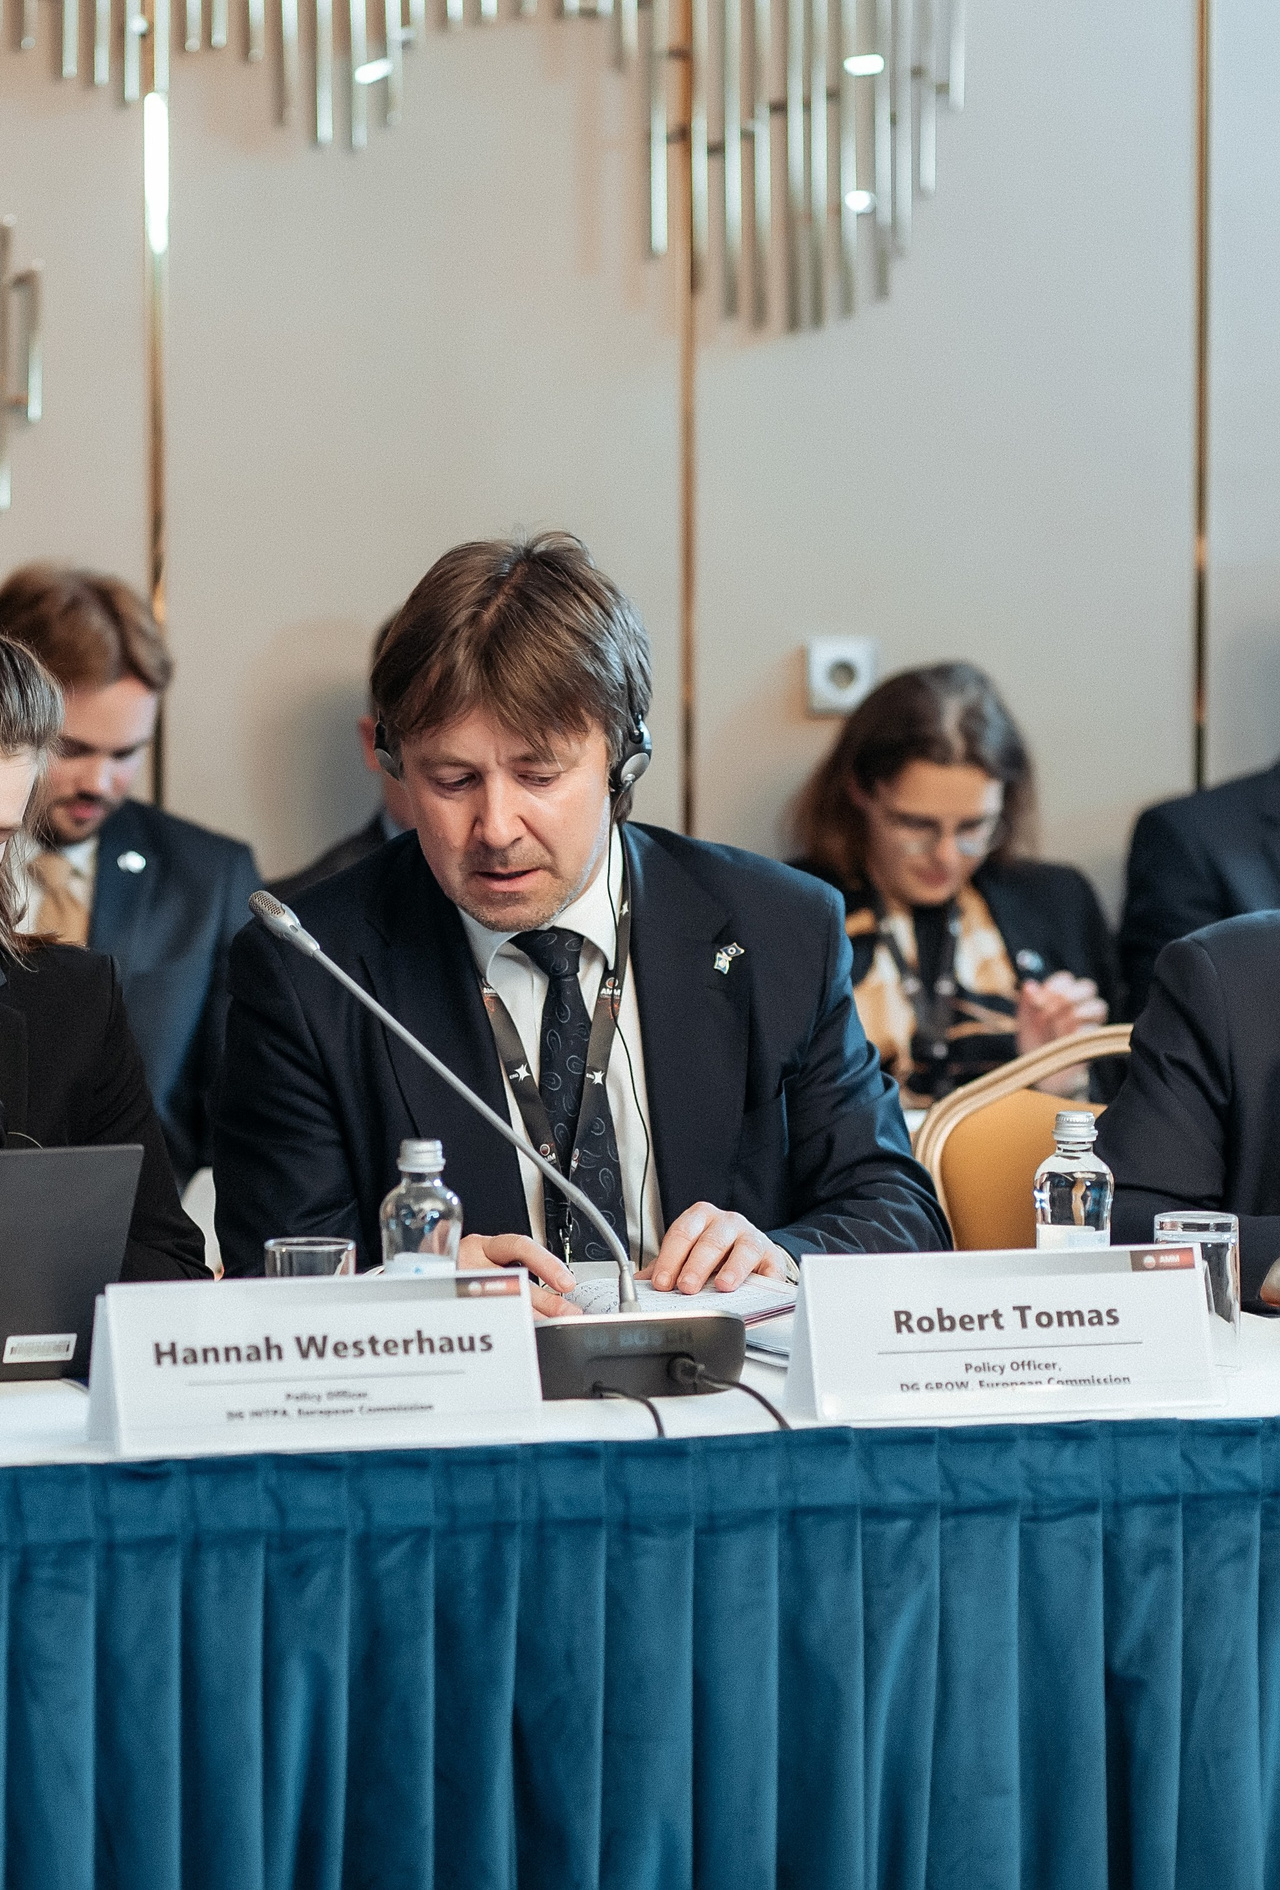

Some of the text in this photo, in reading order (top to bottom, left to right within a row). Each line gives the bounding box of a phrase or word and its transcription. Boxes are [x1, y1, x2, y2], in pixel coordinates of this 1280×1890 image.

[893, 1304, 1121, 1334] Robert Tomas
[153, 1330, 494, 1367] Hannah Westerhaus
[964, 1360, 1062, 1375] Policy Officer,
